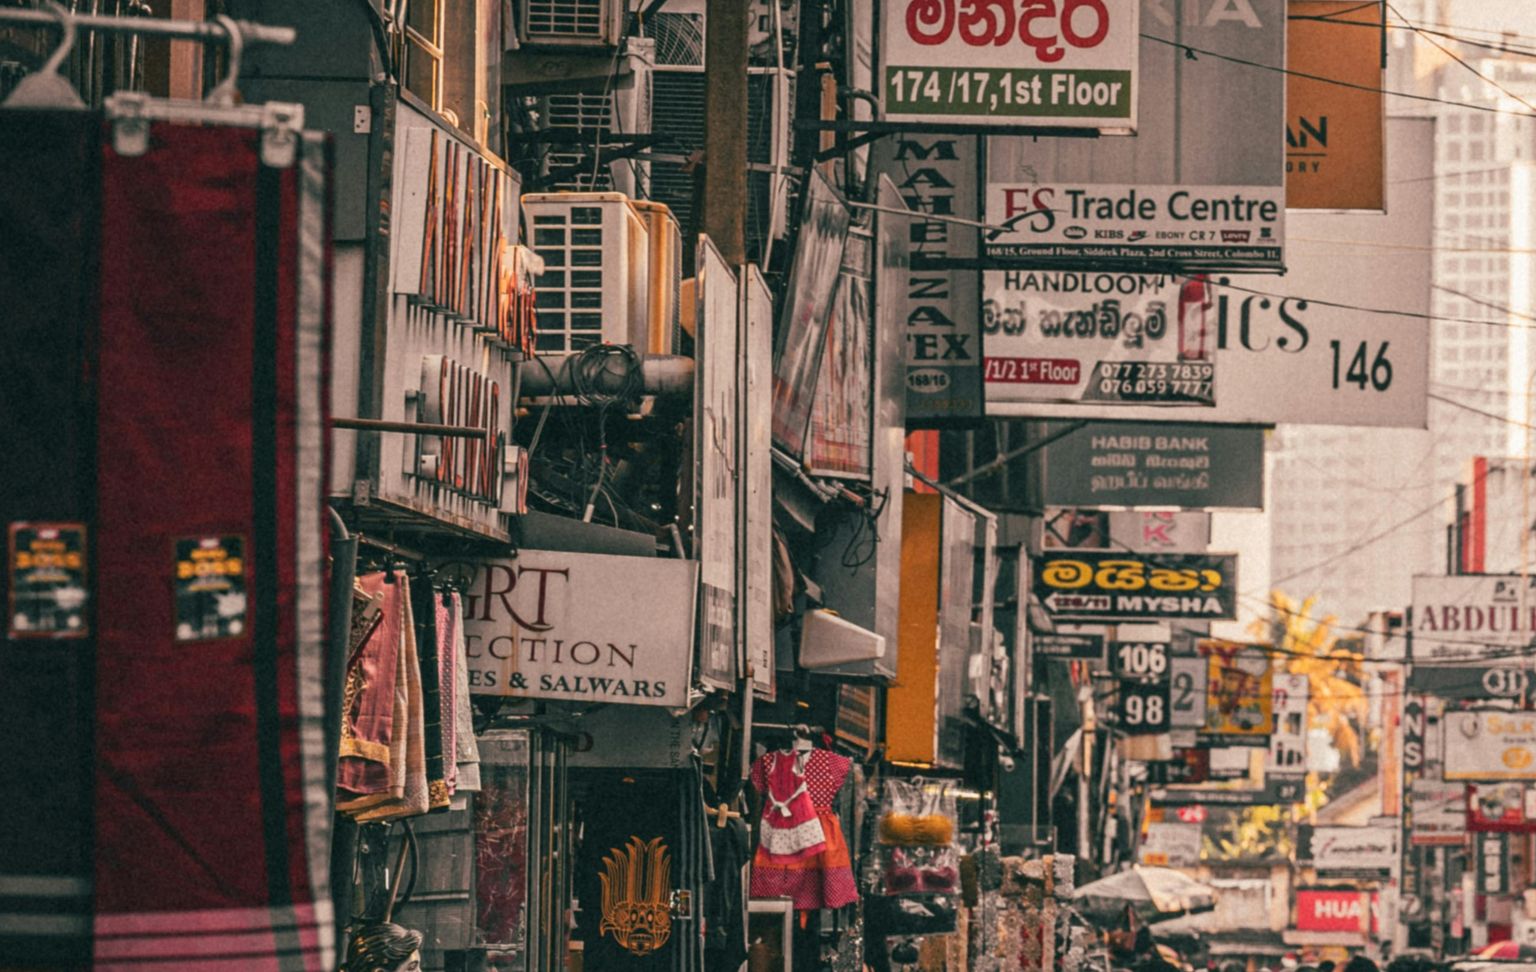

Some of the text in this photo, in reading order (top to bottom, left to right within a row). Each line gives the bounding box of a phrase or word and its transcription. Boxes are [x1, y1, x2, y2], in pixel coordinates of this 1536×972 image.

[891, 70, 941, 102] 174
[1051, 73, 1122, 105] Floor
[1065, 189, 1156, 220] Trade
[1167, 191, 1277, 222] Centre
[1094, 229, 1124, 240] KIBS
[1155, 231, 1185, 240] EBONY
[1019, 246, 1055, 257] Ground
[1055, 247, 1081, 258] Floor,
[1149, 248, 1166, 258] 2nd
[1167, 248, 1192, 258] Cross
[1224, 248, 1264, 259] Colombo
[907, 333, 971, 361] EX
[1039, 360, 1077, 381] Floor
[1101, 363, 1212, 380] 077 273 7839
[1329, 338, 1394, 392] 146
[1101, 379, 1132, 394] 076
[1091, 436, 1209, 450] HABIB BANK
[1117, 595, 1223, 614] MYSHA
[1119, 644, 1167, 673] 106
[509, 671, 528, 689] &
[540, 673, 666, 698] SALWARS
[1125, 695, 1164, 725] 98
